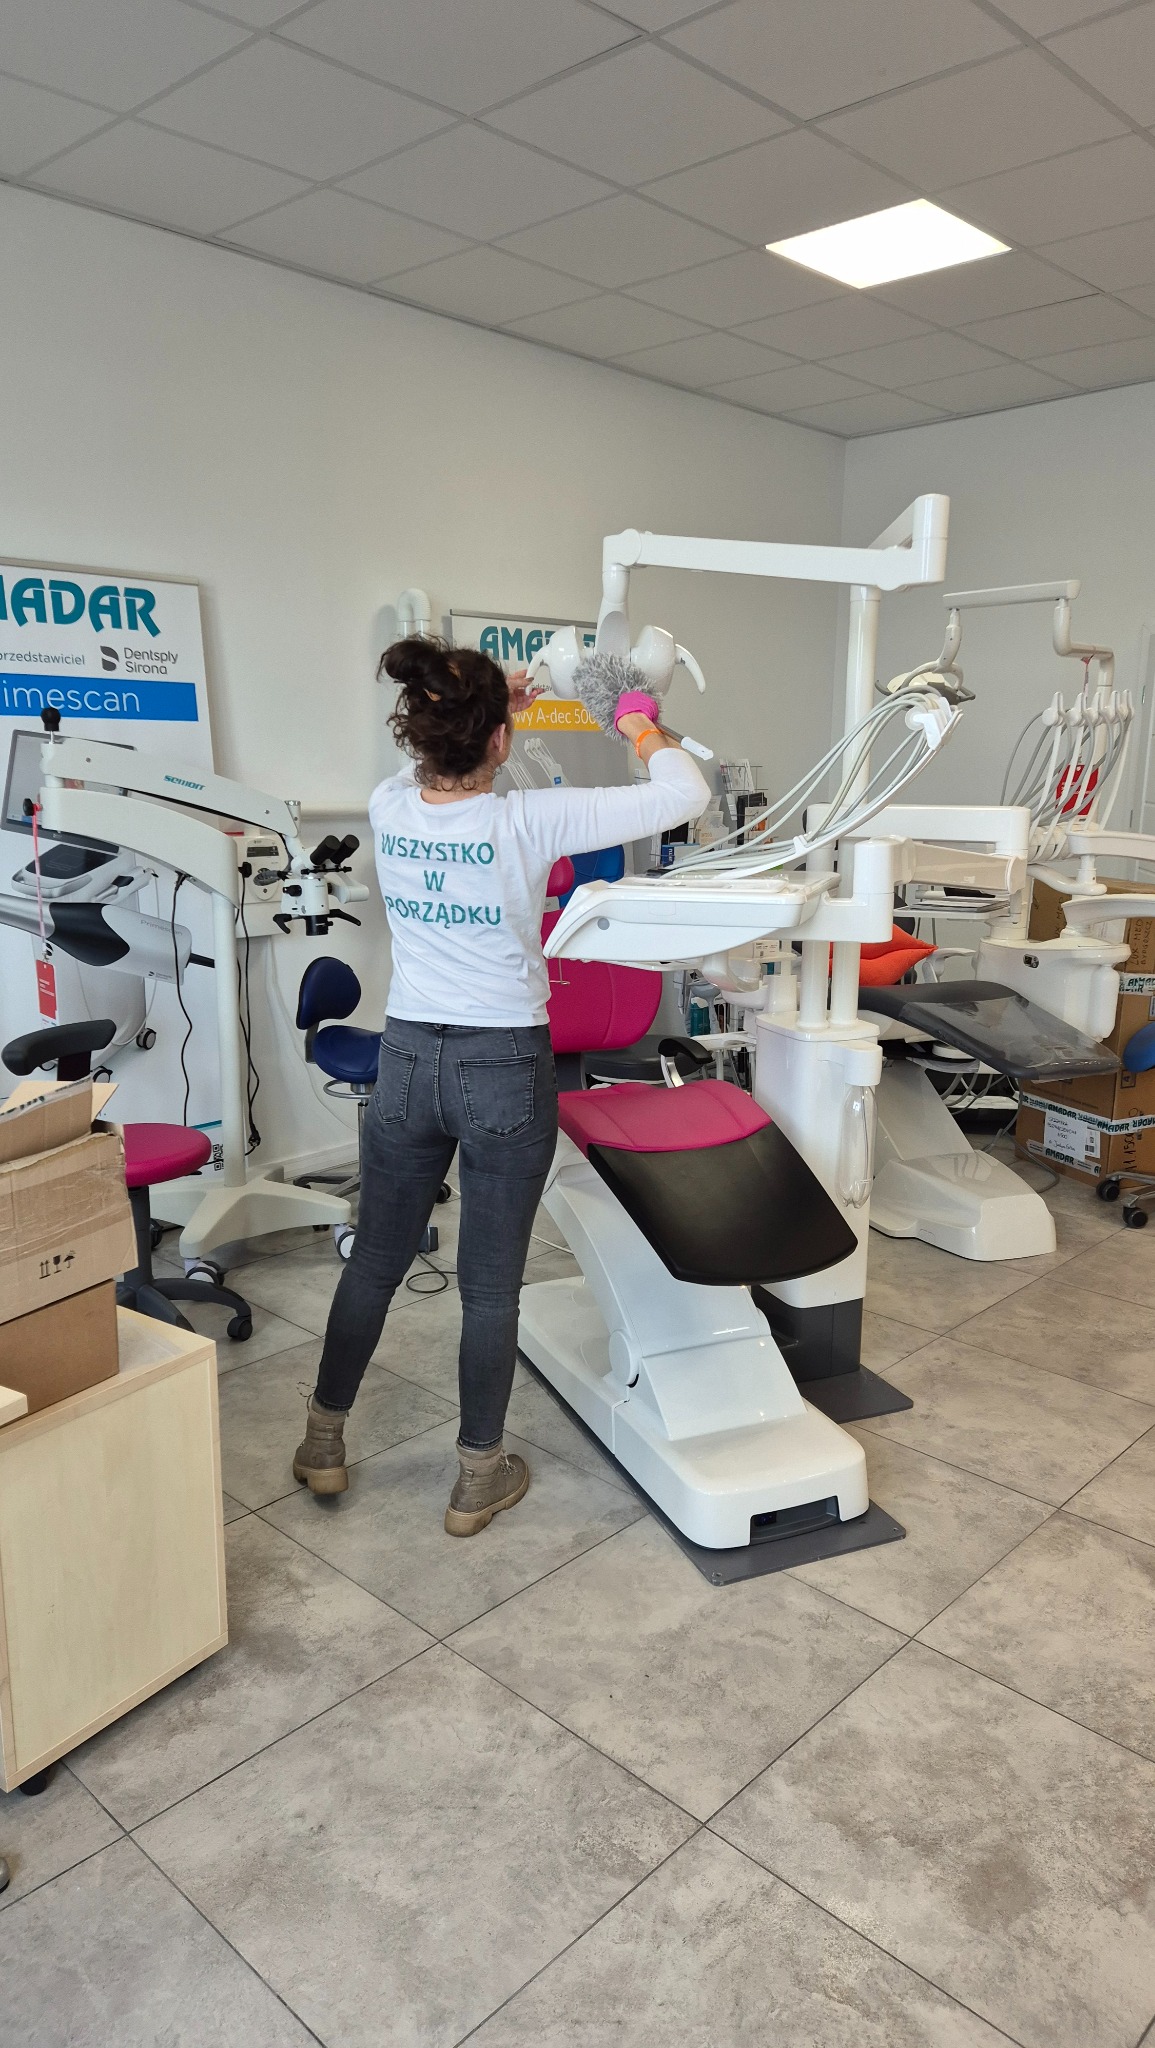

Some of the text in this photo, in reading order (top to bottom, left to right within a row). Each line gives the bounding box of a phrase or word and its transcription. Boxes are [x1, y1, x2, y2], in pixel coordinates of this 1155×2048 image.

[0, 575, 161, 637] ADAR
[480, 626, 597, 664] AMA
[124, 648, 178, 664] Dentsply
[126, 661, 168, 675] Sirona
[513, 711, 533, 726] wy
[536, 709, 570, 724] A-dec
[381, 832, 495, 865] WSZYSTKO
[423, 870, 446, 892] W
[385, 895, 501, 929] PORZĄDKU
[1047, 1103, 1077, 1120] AMADAR
[1096, 1120, 1130, 1133] AMADAR
[1045, 1147, 1075, 1166] AMADAR
